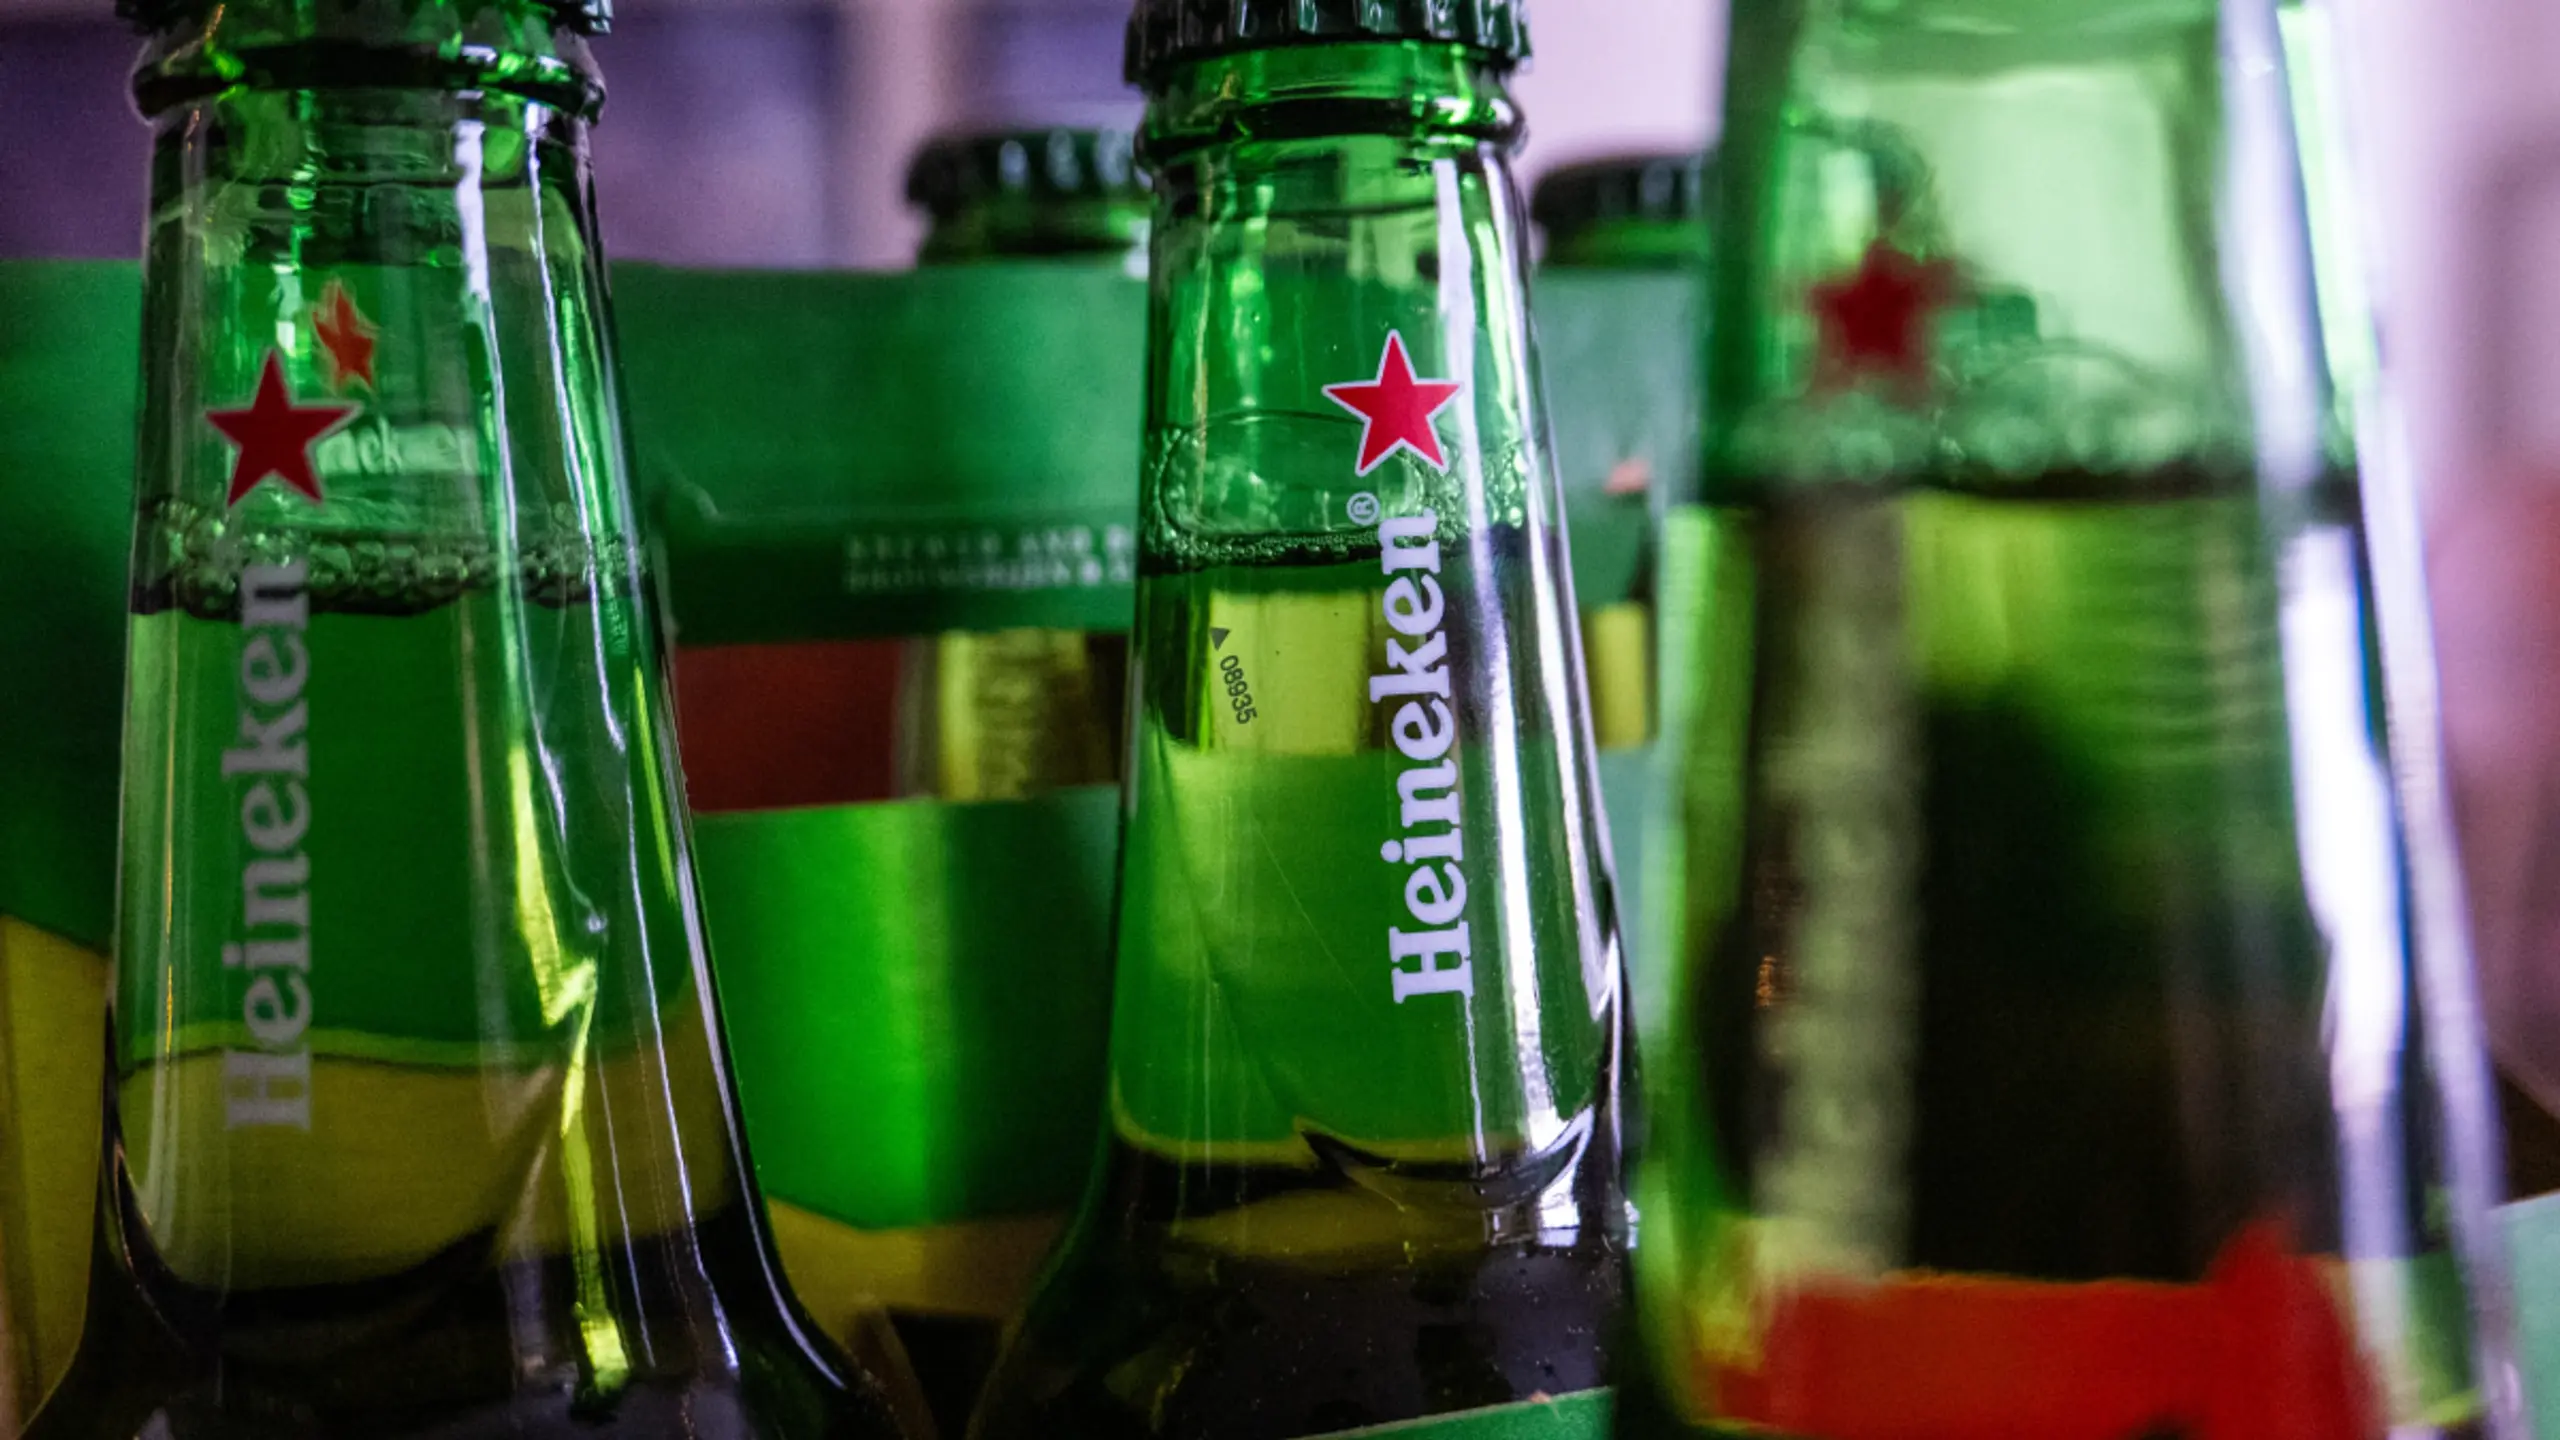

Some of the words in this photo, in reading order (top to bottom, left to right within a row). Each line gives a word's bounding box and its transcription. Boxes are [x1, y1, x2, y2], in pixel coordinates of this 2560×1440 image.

[221, 558, 312, 1132] Heineken
[1220, 654, 1258, 725] 08935
[1370, 507, 1474, 1005] Heineken
